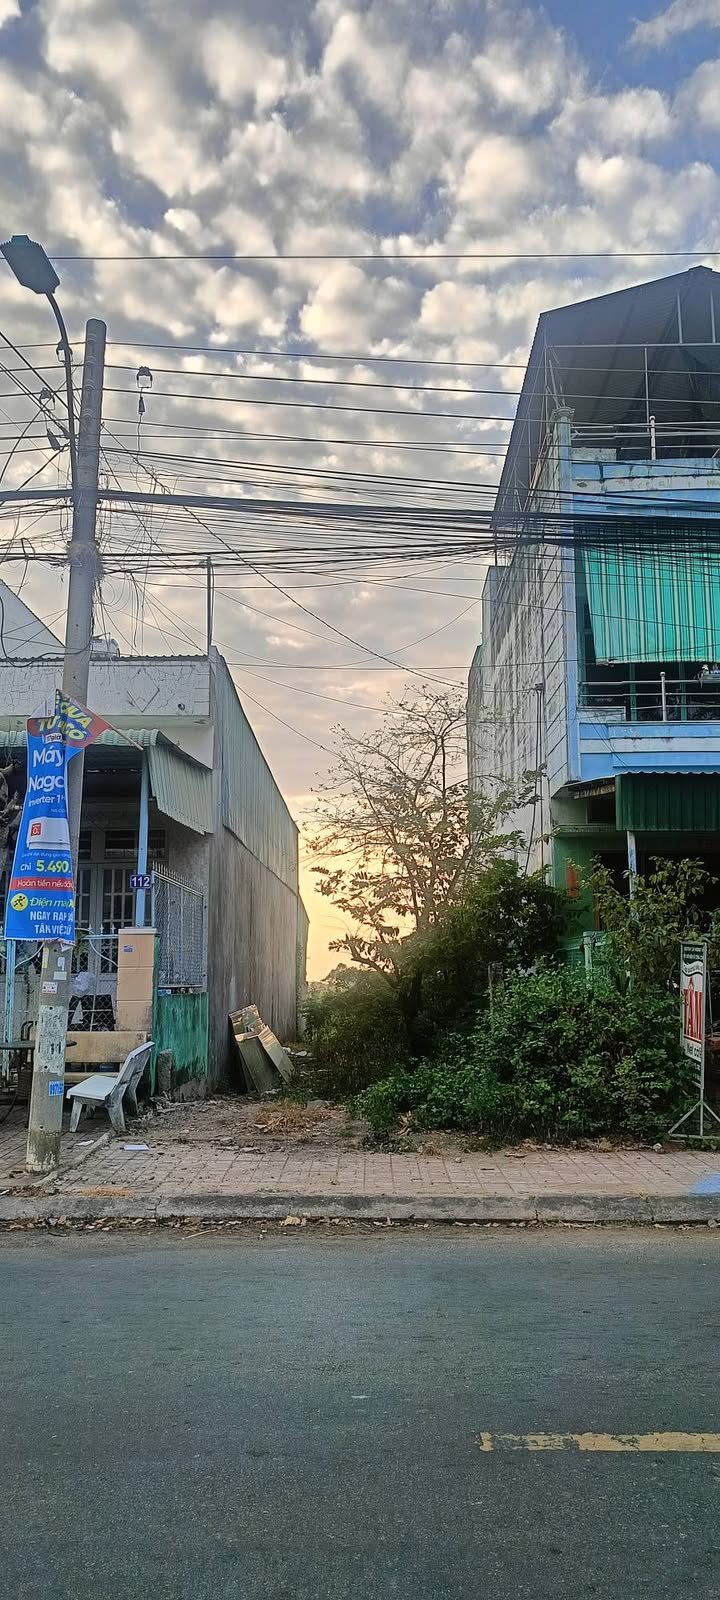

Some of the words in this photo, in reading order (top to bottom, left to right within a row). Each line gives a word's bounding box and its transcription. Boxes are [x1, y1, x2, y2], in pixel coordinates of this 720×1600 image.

[32, 745, 64, 768] Máy
[131, 876, 150, 887] 112
[29, 897, 53, 909] Điện
[30, 911, 51, 921] NGAY
